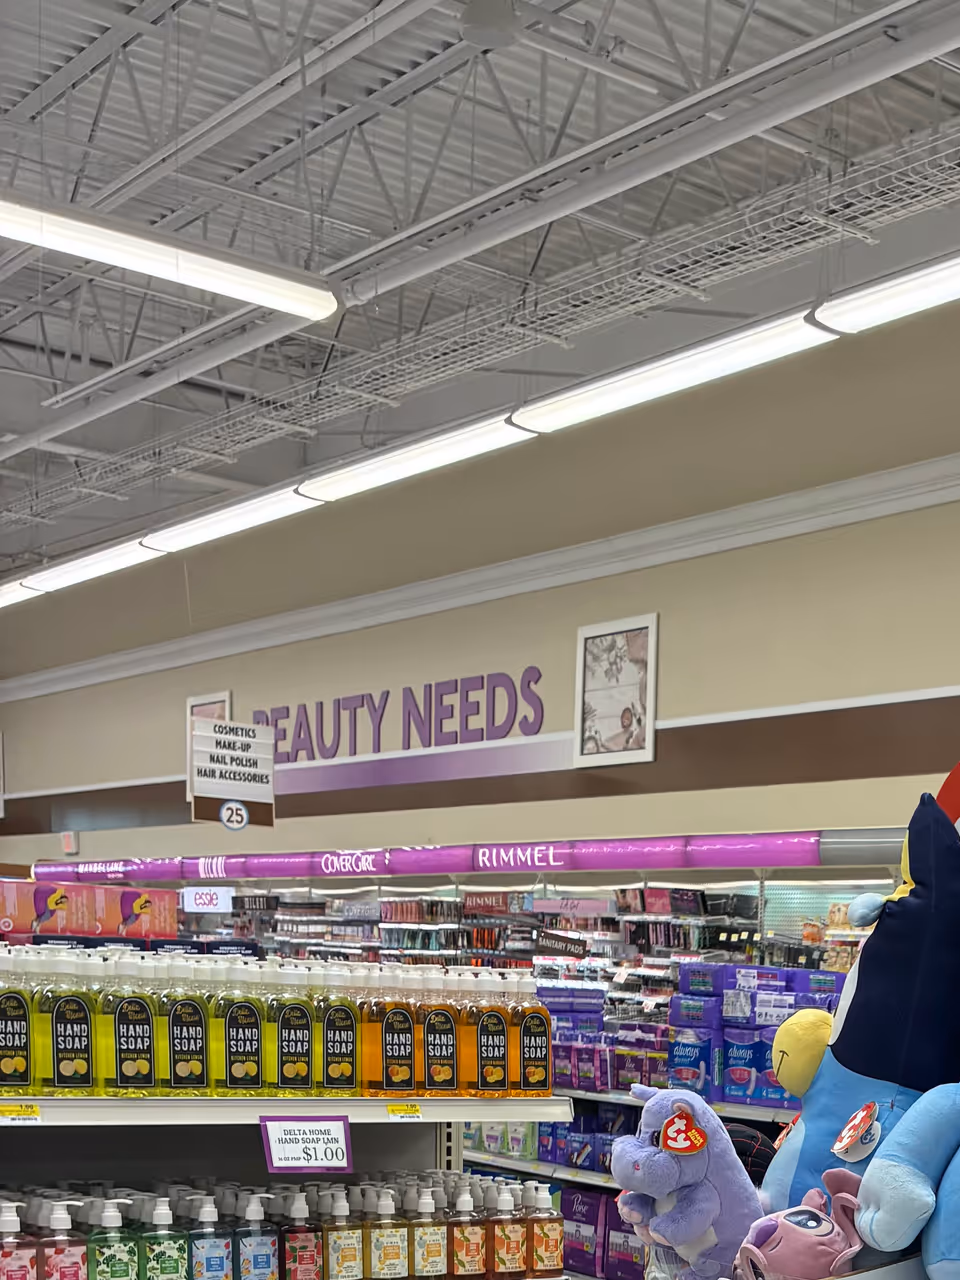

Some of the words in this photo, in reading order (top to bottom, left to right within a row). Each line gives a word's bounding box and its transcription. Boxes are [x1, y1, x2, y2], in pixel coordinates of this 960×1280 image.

[402, 666, 543, 749] NEEDS
[213, 724, 256, 739] COSMETICS
[215, 739, 251, 753] MAKE-UP
[209, 754, 228, 766] NAIL
[230, 756, 258, 769] POLISH
[197, 768, 216, 779] HAIR
[218, 770, 270, 784] ACCESSORIES
[225, 806, 245, 824] 25
[478, 846, 564, 868] RIMMEL
[194, 889, 218, 907] essie
[466, 894, 505, 907] RIMMEL
[538, 937, 566, 951] SANITARY
[567, 944, 584, 955] PADS
[0, 1020, 27, 1033] HAND
[57, 1023, 88, 1036] HAND
[119, 1024, 150, 1037] HAND
[173, 1025, 202, 1038] HAND
[0, 1034, 27, 1047] SOAP
[229, 1028, 258, 1040] HAND
[282, 1029, 309, 1041] HAND
[327, 1030, 353, 1042] HAND
[386, 1033, 411, 1045] HAND
[428, 1033, 453, 1045] HAND
[481, 1035, 505, 1046] HAND
[57, 1036, 88, 1050] SOAP
[120, 1037, 150, 1050] SOAP
[174, 1039, 202, 1051] SOAP
[230, 1040, 258, 1053] SOAP
[282, 1041, 309, 1054] SOAP
[327, 1042, 353, 1054] SOAP
[524, 1036, 547, 1047] HAND
[386, 1045, 411, 1056] SOAP
[428, 1045, 453, 1056] SOAP
[481, 1046, 505, 1058] SOAP
[524, 1047, 547, 1058] SOAP
[673, 1043, 700, 1061] always
[728, 1045, 753, 1063] always
[667, 1117, 691, 1148] ty
[302, 1145, 345, 1164] $1.00
[572, 1194, 589, 1214] Poise
